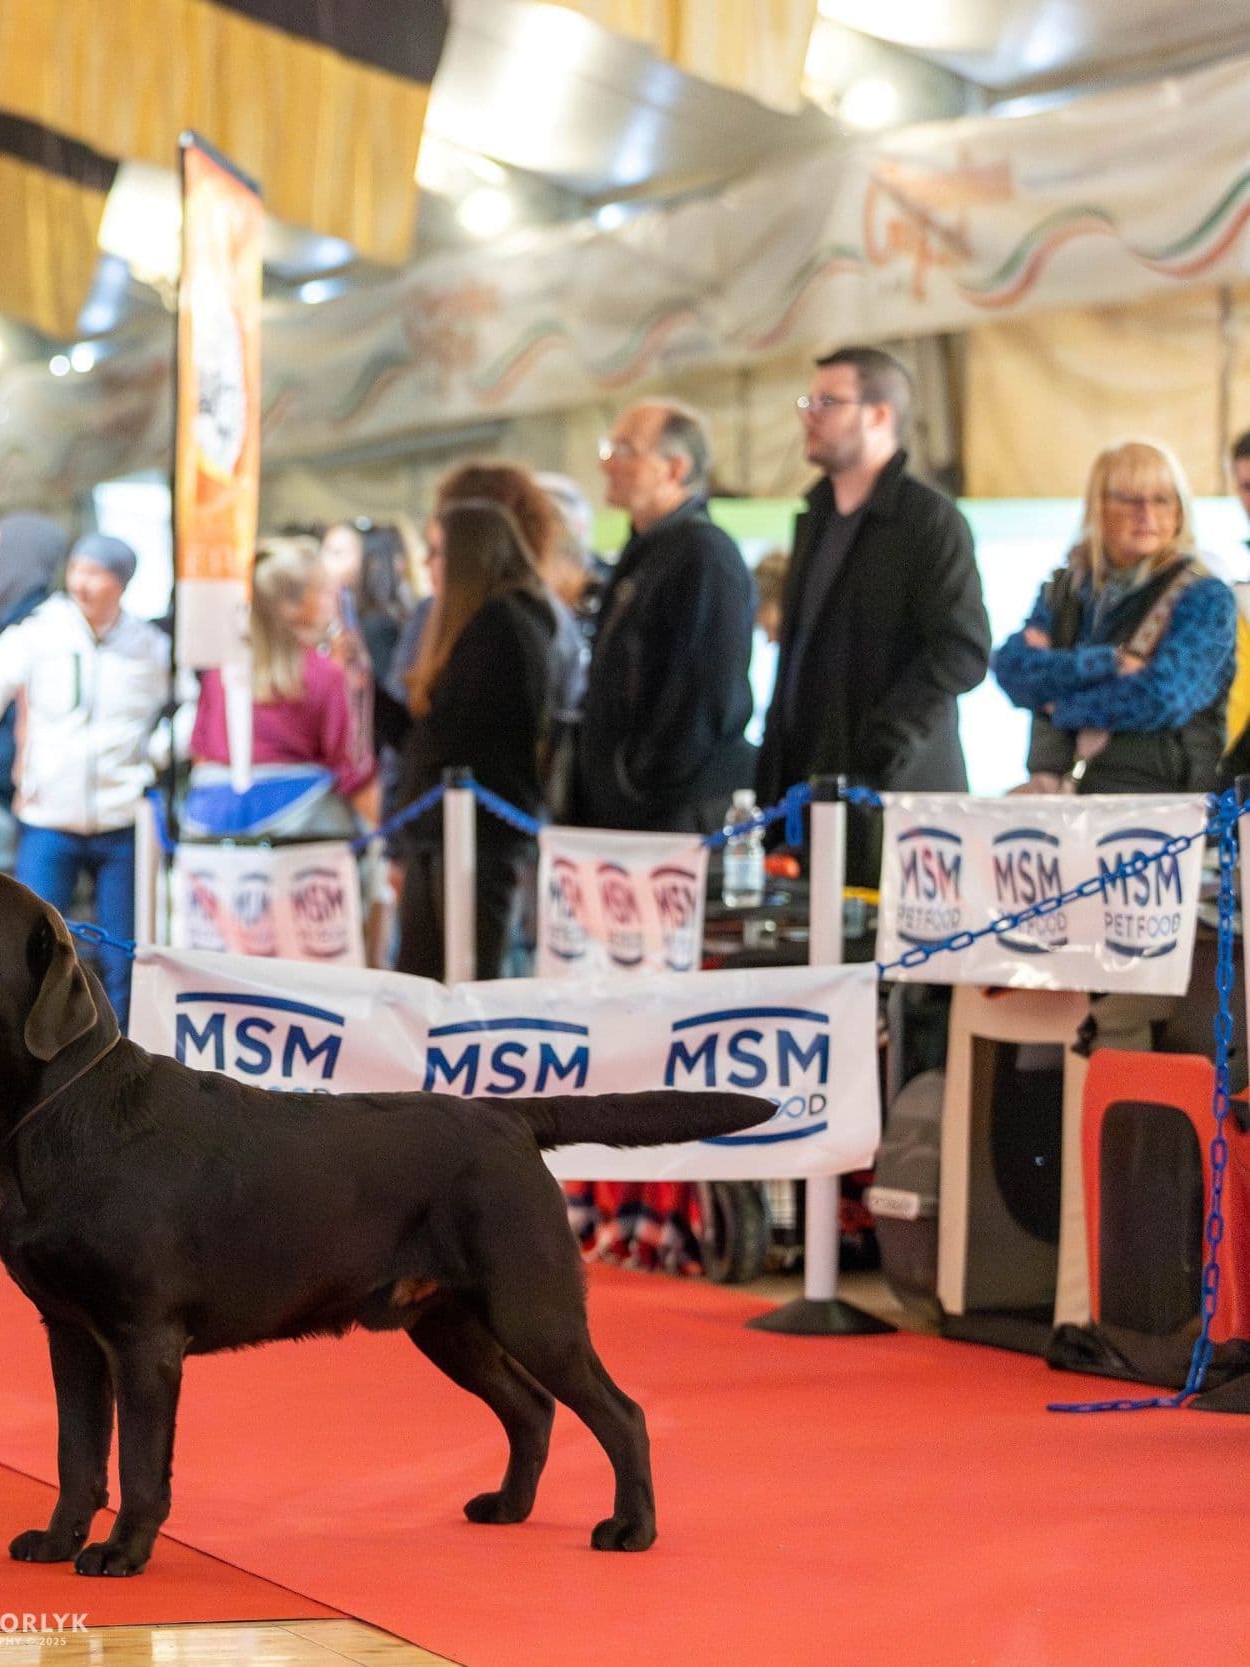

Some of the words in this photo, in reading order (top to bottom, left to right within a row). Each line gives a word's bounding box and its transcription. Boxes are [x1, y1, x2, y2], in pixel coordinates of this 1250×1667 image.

[900, 848, 962, 900] MSM
[993, 849, 1063, 905] MSM
[1098, 850, 1183, 907] MSM
[175, 1012, 343, 1080] MSM
[422, 1041, 590, 1096] MSM
[664, 1029, 831, 1089] MSM
